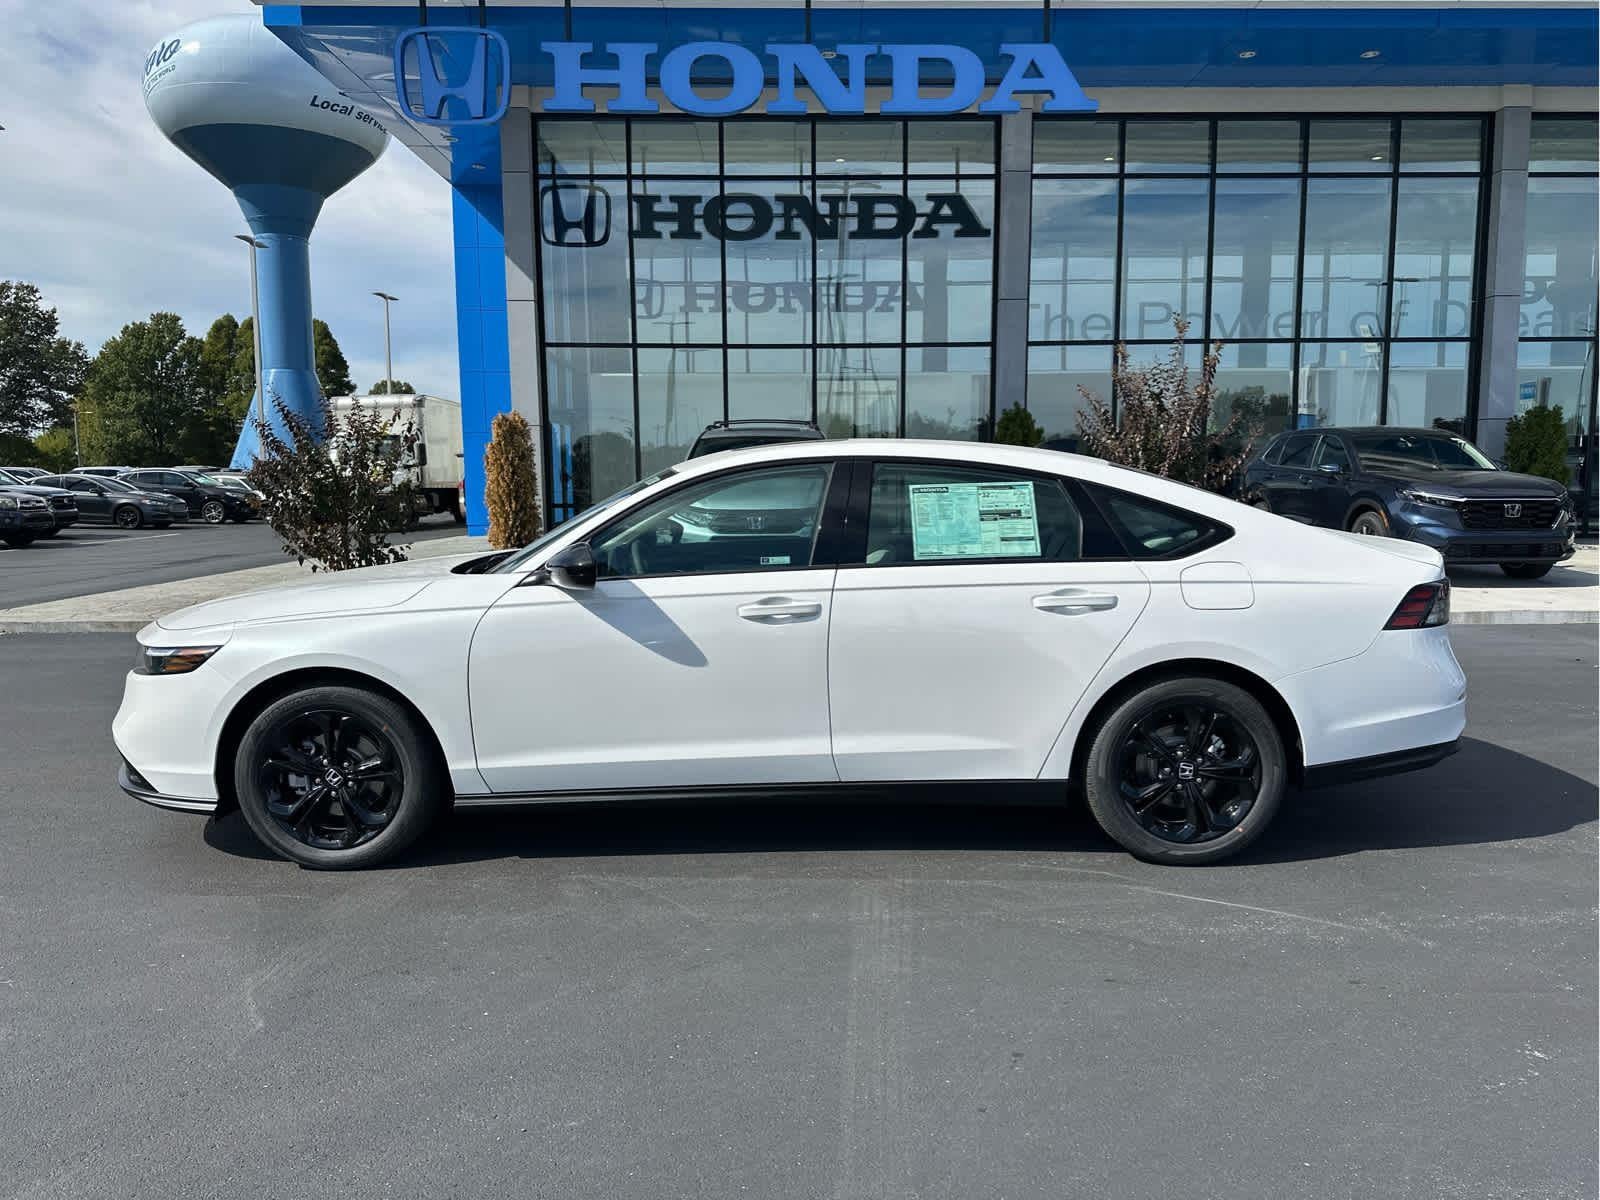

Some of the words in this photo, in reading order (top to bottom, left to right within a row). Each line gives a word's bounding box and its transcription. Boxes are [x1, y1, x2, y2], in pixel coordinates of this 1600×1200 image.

[540, 40, 1098, 115] HONDA
[310, 95, 355, 116] Local
[631, 192, 992, 240] HONDA
